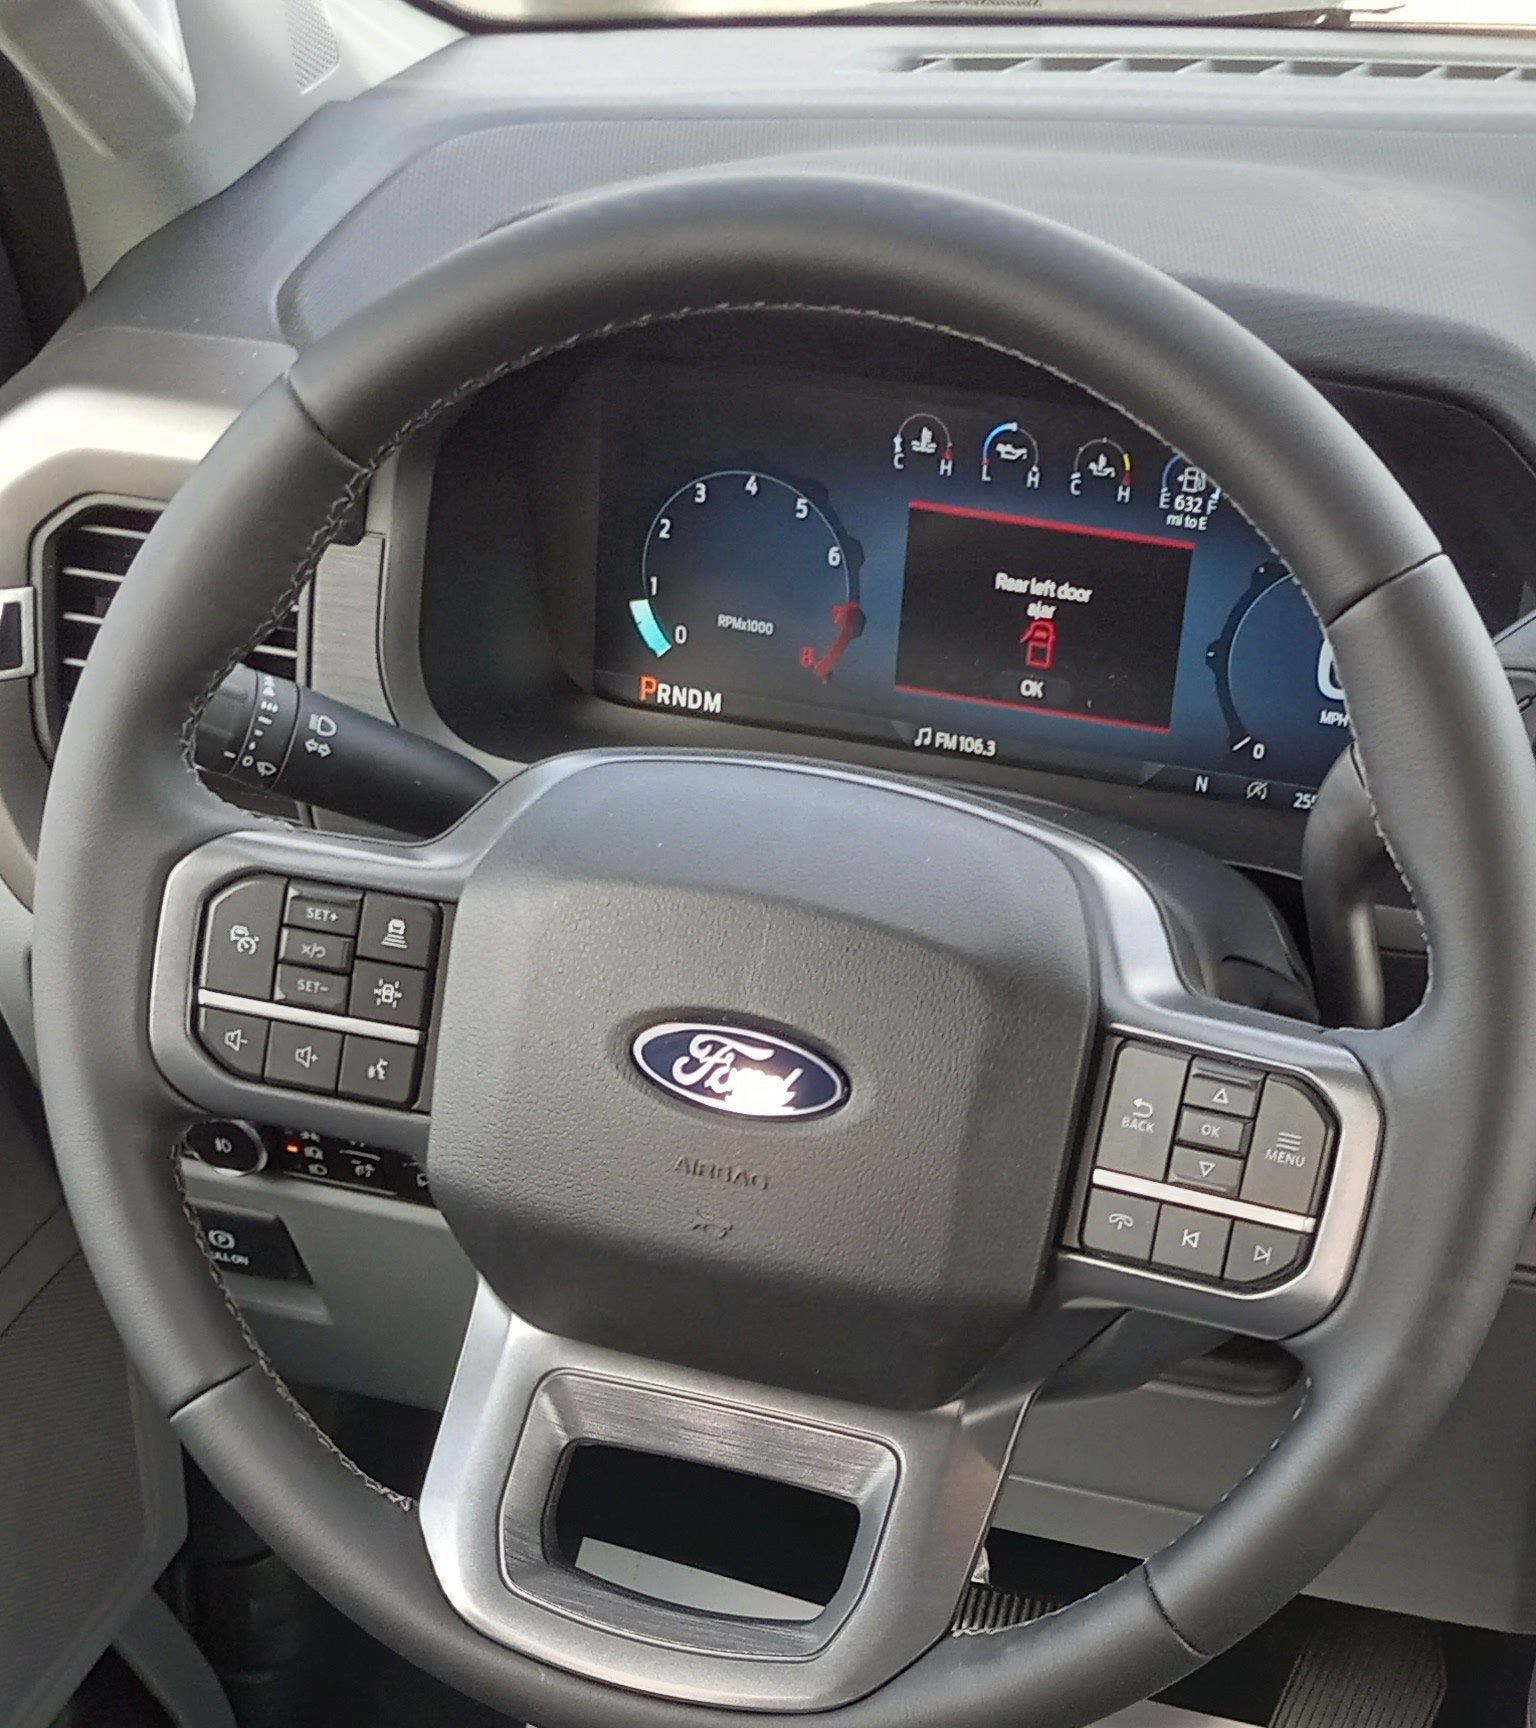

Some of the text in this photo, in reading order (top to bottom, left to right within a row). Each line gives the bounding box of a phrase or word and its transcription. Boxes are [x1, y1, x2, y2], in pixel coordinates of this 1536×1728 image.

[893, 453, 904, 470] C
[939, 459, 953, 477] H
[981, 464, 992, 482] L
[1026, 471, 1040, 489] H
[694, 483, 707, 503] 3
[745, 475, 758, 496] 4
[1070, 479, 1081, 496] C
[1117, 485, 1131, 503] H
[796, 498, 808, 519] 5
[1159, 493, 1170, 509] E
[1174, 495, 1202, 514] 632
[1207, 499, 1218, 515] F
[659, 518, 671, 539] 2
[1166, 514, 1208, 531] mi to E
[828, 546, 841, 566] 6
[650, 576, 658, 596] 1
[995, 572, 1093, 604] Rear left door
[1027, 601, 1057, 620] ajar
[717, 614, 774, 636] RPMx1000
[674, 625, 687, 645] 0
[800, 646, 814, 668] 8
[1020, 679, 1045, 699] OK
[1319, 709, 1349, 728] MPH
[934, 732, 996, 757] FM 106.3
[1252, 744, 1265, 760] 0
[1195, 775, 1209, 793] N
[1121, 1116, 1155, 1134] BACK
[1200, 1122, 1221, 1138] OK
[1265, 1148, 1306, 1168] MENU
